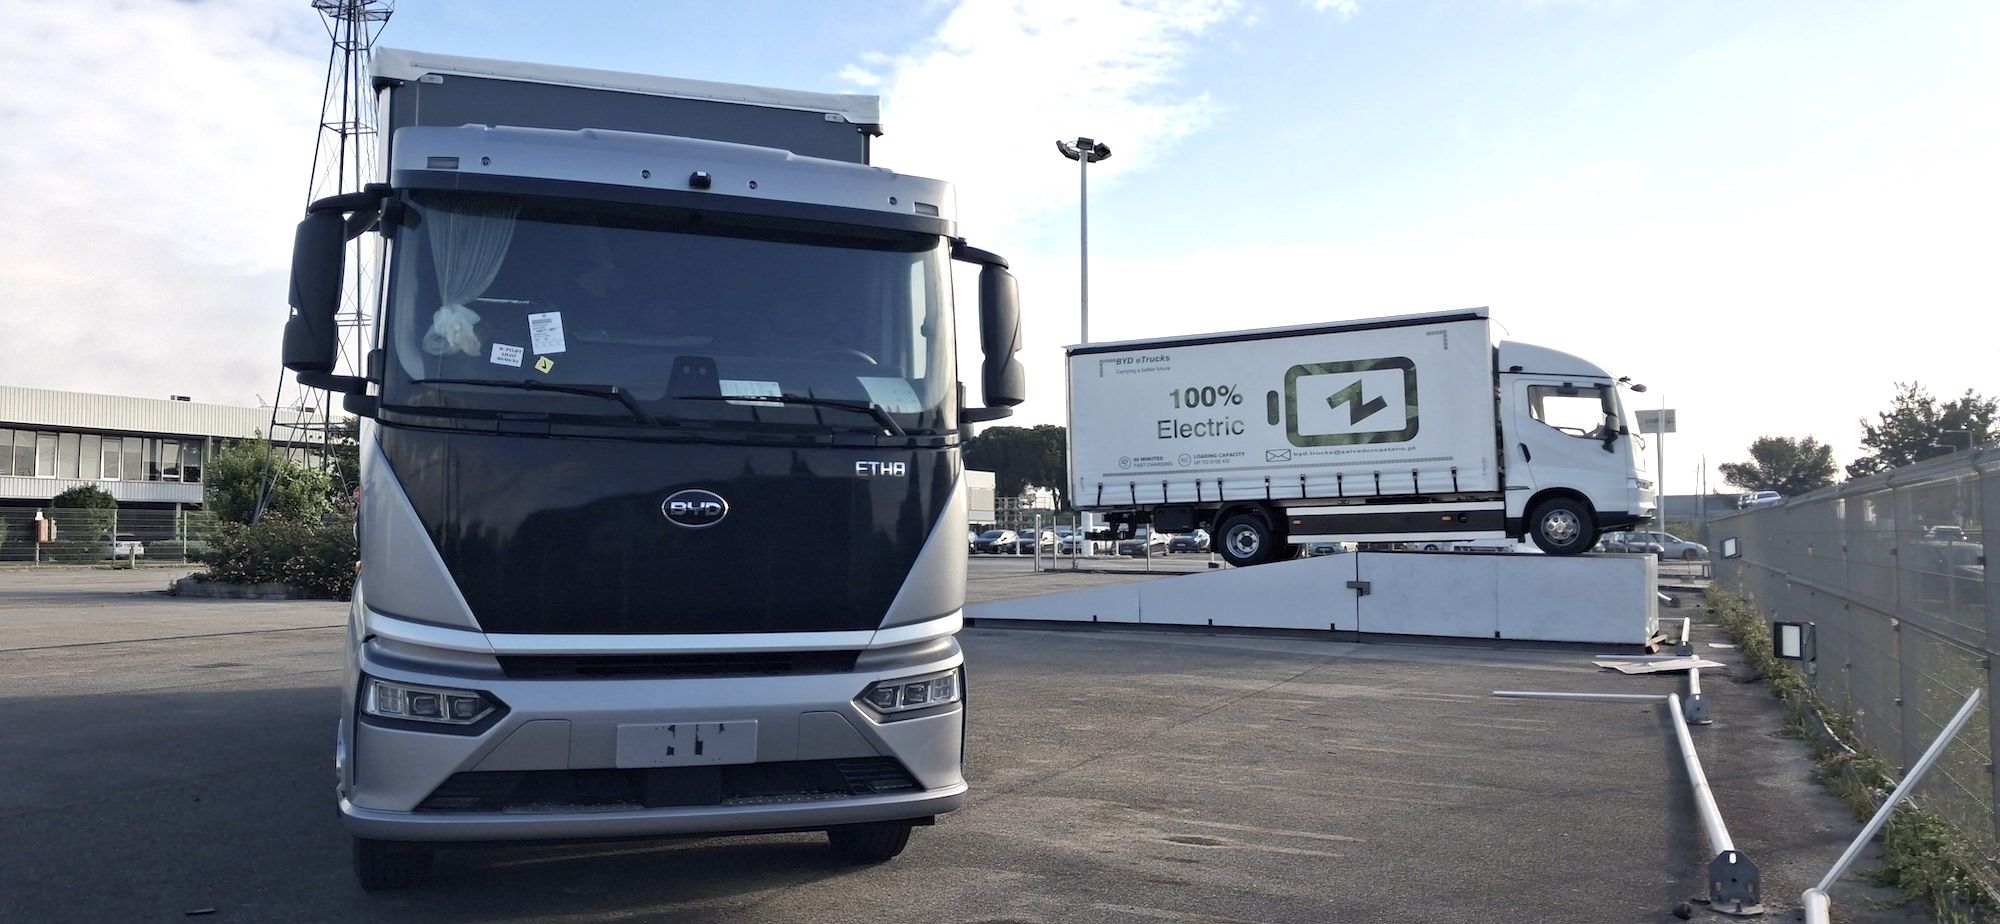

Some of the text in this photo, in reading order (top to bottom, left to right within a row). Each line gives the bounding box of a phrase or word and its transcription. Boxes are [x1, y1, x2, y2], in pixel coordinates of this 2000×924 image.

[1116, 354, 1170, 366] BYD eTrucks
[1169, 383, 1244, 409] 100%
[1157, 416, 1245, 440] Electric
[669, 501, 722, 516] BYD
